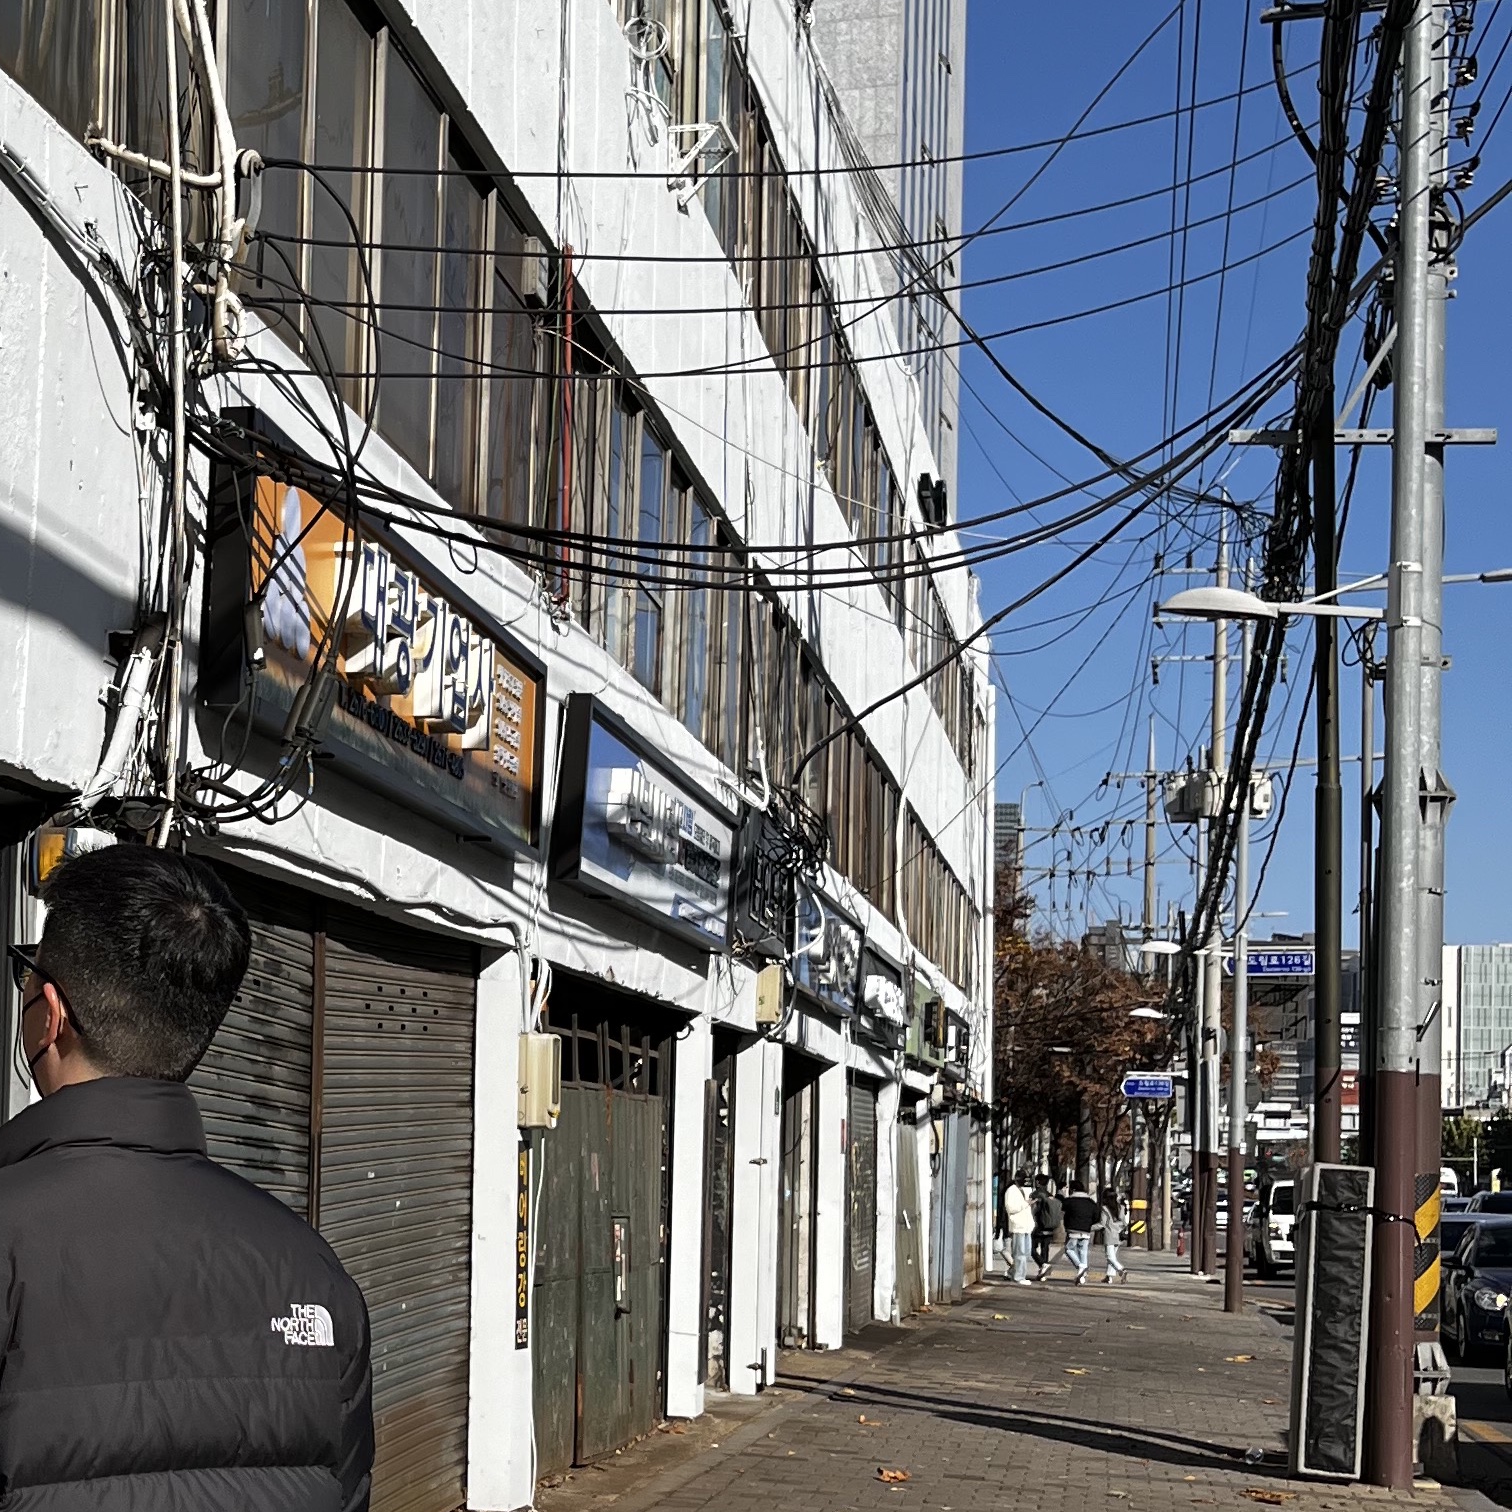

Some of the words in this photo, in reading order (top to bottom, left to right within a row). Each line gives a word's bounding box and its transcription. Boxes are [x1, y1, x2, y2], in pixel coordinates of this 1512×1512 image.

[348, 541, 496, 751] 대광기업사
[290, 1304, 316, 1318] THE
[270, 1317, 314, 1332] NORTH
[284, 1331, 316, 1345] FACE
